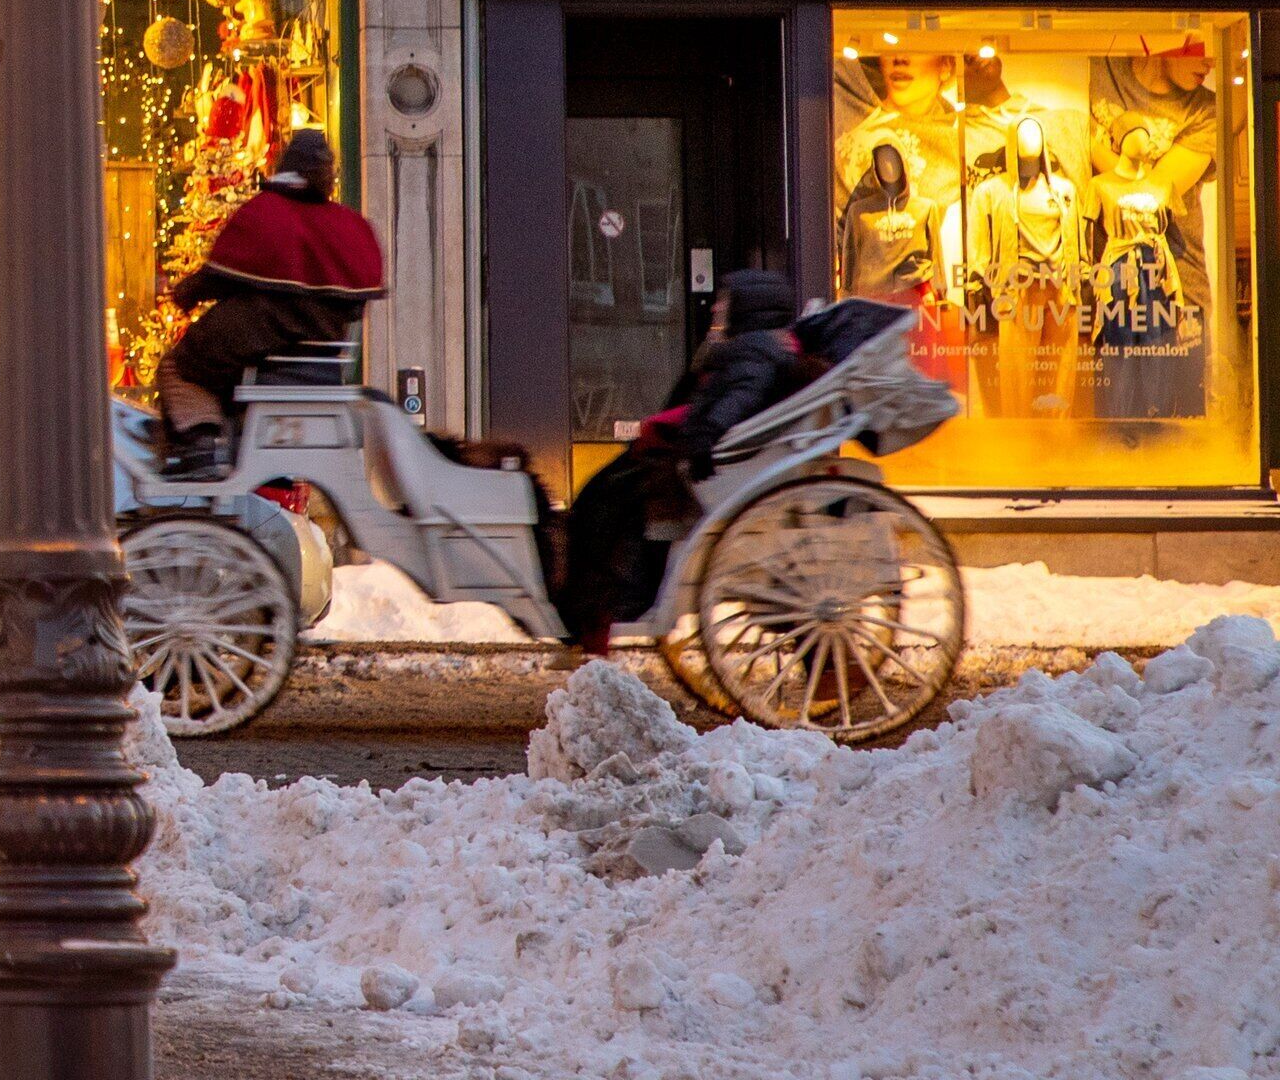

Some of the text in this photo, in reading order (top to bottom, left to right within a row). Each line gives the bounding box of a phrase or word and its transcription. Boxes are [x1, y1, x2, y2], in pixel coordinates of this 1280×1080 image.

[983, 261, 1163, 291] CONFORT
[959, 294, 1200, 333] MOUVEMENT
[910, 342, 928, 357] La
[931, 341, 988, 360] journée
[1100, 342, 1120, 357] du
[1123, 342, 1190, 360] pantalon
[1080, 377, 1112, 388] 2020
